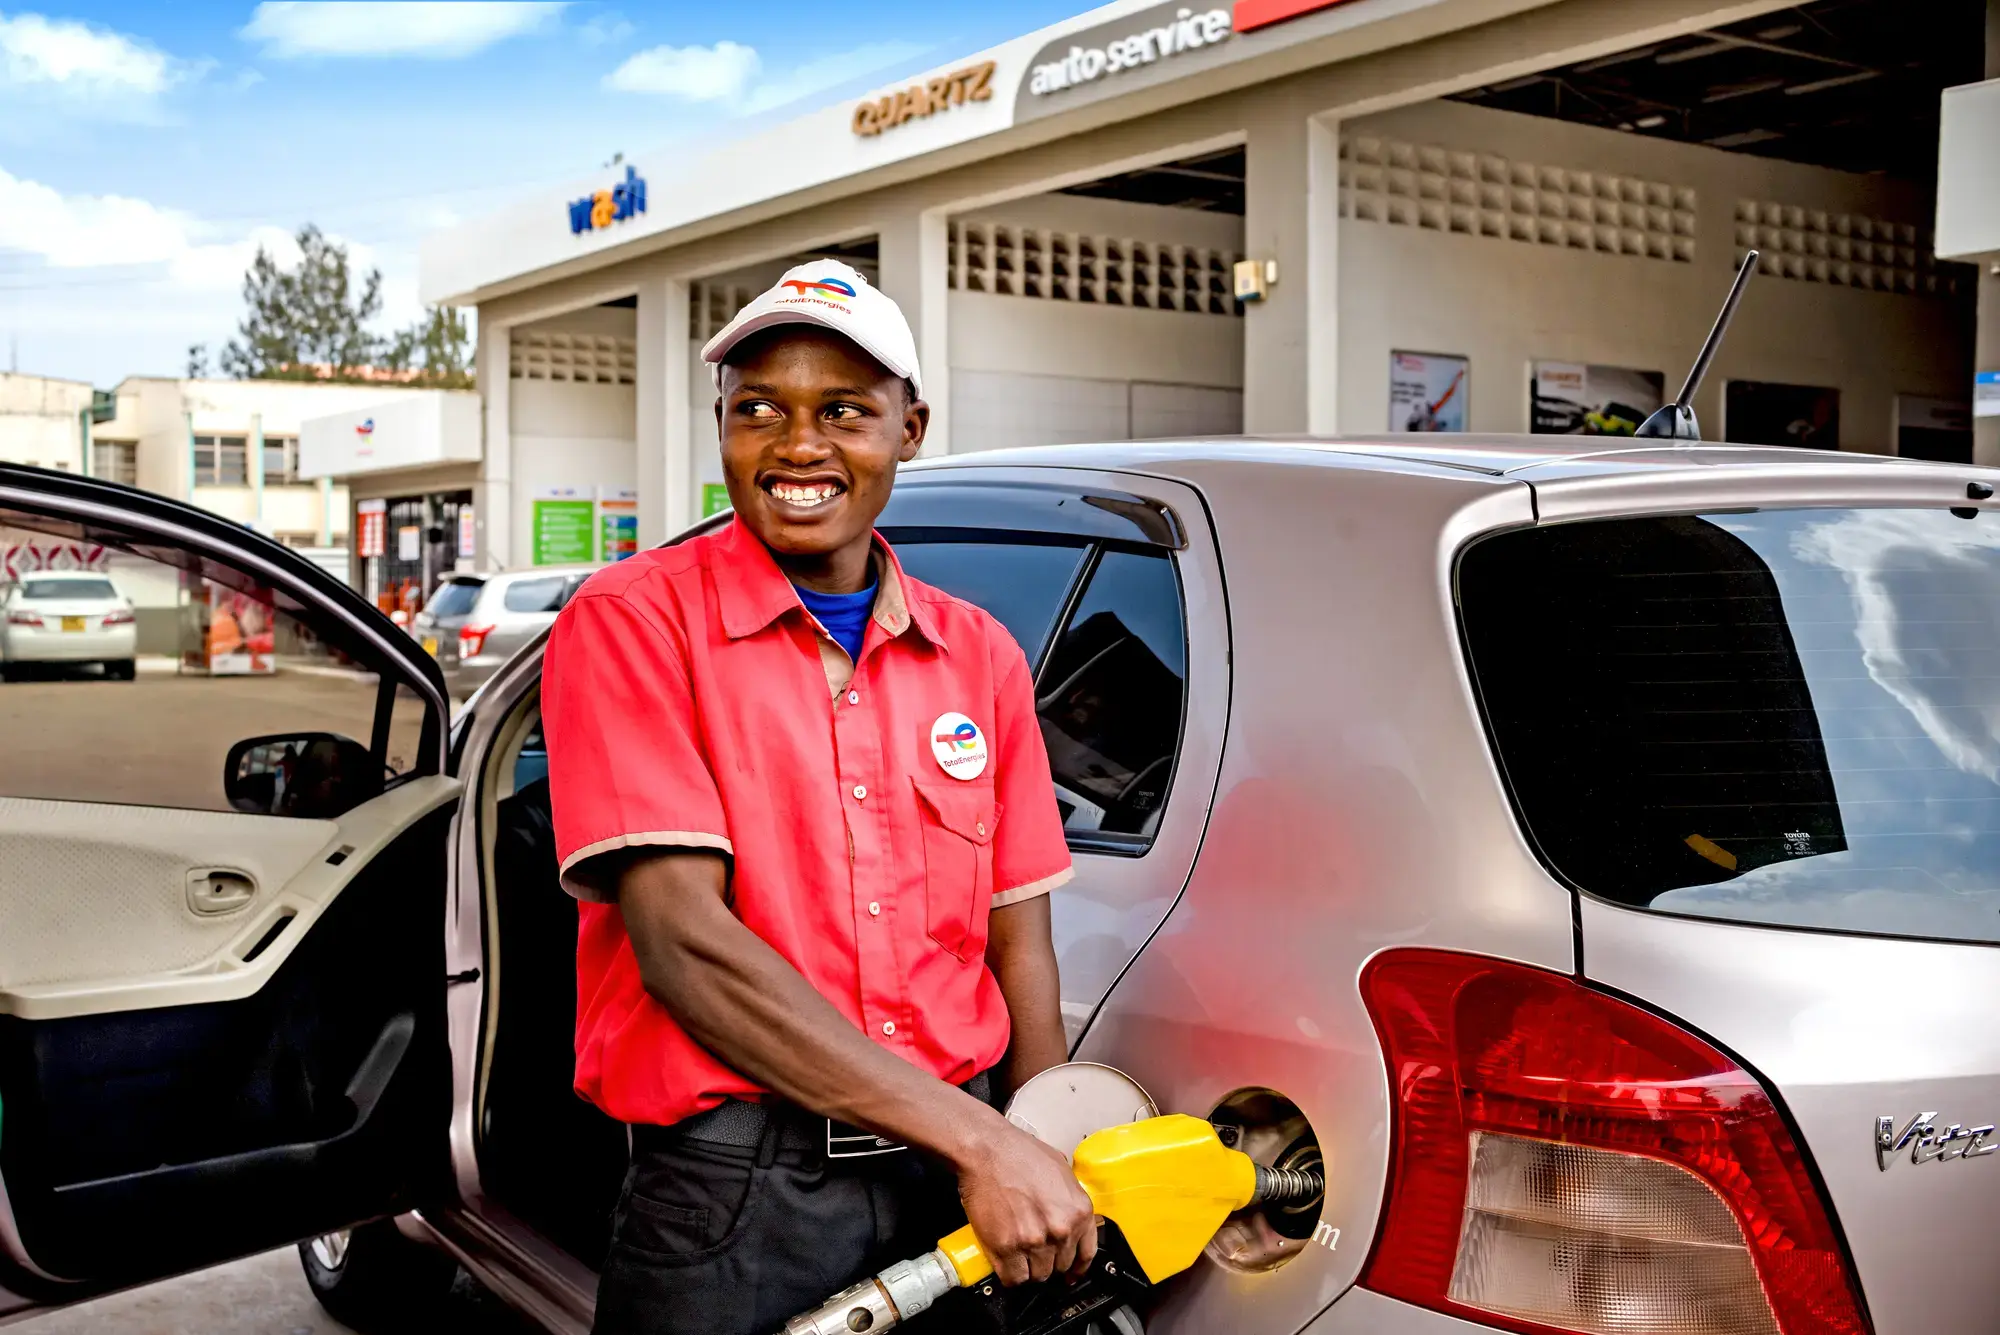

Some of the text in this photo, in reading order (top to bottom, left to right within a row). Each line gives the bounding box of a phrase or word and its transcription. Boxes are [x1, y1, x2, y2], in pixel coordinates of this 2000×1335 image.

[852, 60, 996, 137] QUARTZ
[568, 165, 647, 235] wash
[943, 753, 986, 768] TotalEnergies
[1875, 1111, 1998, 1172] Vitz
